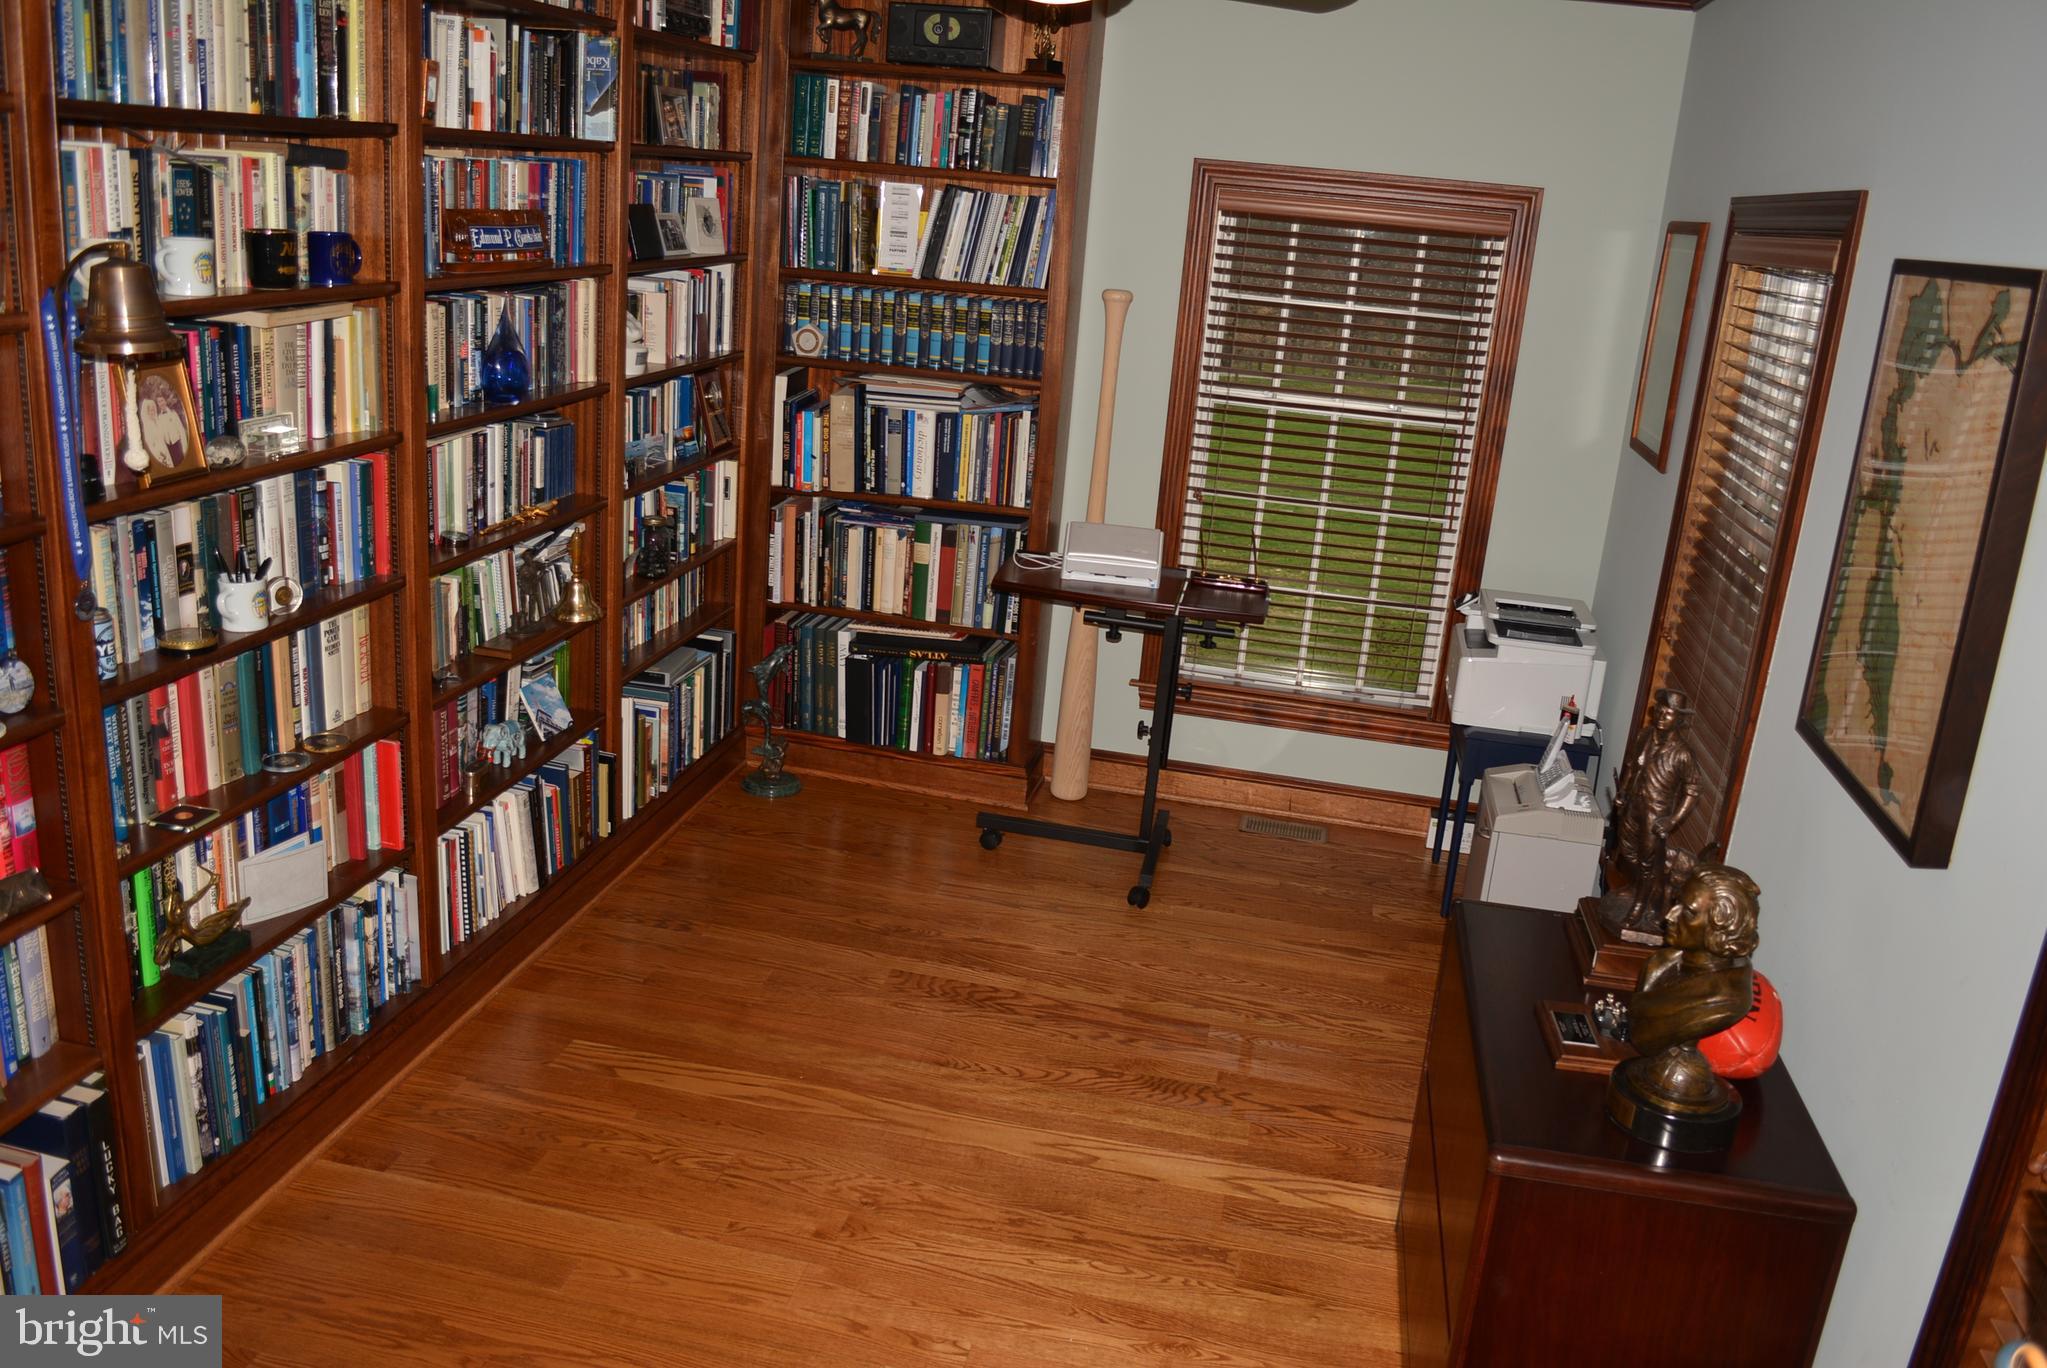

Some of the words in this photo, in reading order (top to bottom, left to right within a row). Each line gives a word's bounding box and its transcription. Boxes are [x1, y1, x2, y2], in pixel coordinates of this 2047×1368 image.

[132, 172, 140, 217] SILENT
[50, 332, 58, 350] MAKER
[53, 351, 62, 370] COFFEE
[58, 386, 66, 414] CHAMPION
[99, 374, 108, 399] IMAGES
[102, 410, 111, 460] ORGANIZATION
[909, 649, 949, 660] ATLAS
[135, 700, 144, 721] Clear
[104, 716, 114, 744] FLEET
[110, 714, 120, 748] WHERE
[107, 746, 118, 780] BEGINS
[120, 706, 132, 758] AMERICAN
[126, 764, 136, 812] SOLDIER
[138, 743, 148, 774] Present
[140, 776, 150, 806] Danger
[334, 948, 344, 976] Keepers
[12, 967, 26, 1004] Eternal
[16, 1007, 30, 1056] Darkness
[102, 1140, 117, 1196] LUCKY
[112, 1204, 124, 1238] BAG
